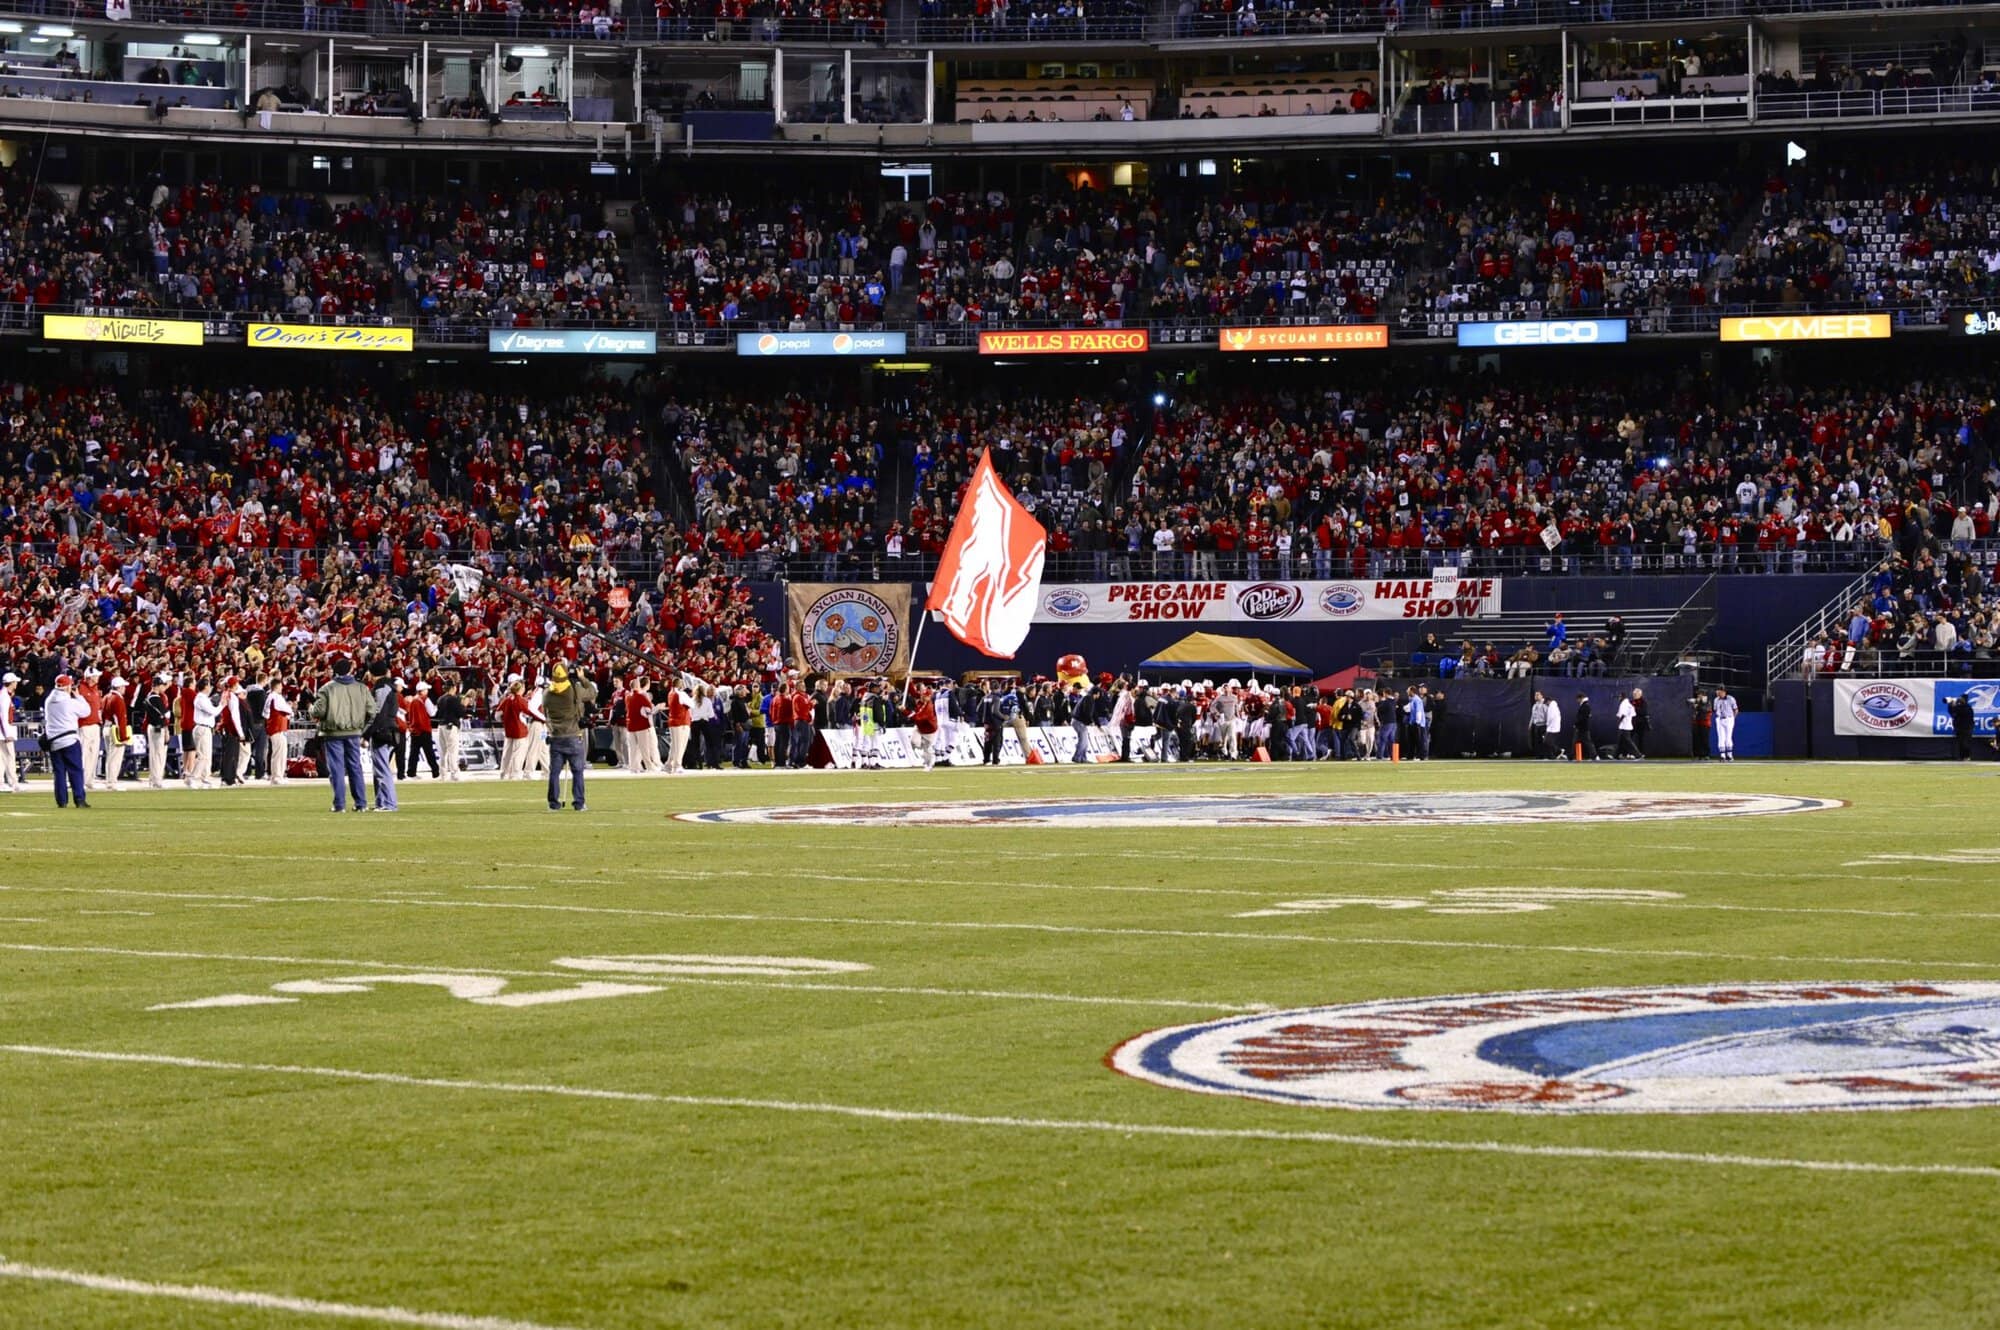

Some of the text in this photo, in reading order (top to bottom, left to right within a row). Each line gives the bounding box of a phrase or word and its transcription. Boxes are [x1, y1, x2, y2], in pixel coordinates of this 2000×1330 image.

[254, 326, 404, 347] Oggi's Pizza
[1494, 321, 1598, 345] GEICO
[1739, 317, 1872, 339] CYMER
[516, 335, 565, 351] Degree
[599, 336, 647, 352] Degree
[779, 338, 811, 351] pepsi
[854, 337, 885, 350] pepsi
[984, 333, 1144, 351] WELLS FARGO
[1258, 331, 1383, 345] SYCUAN RESORT
[241, 532, 252, 543] 12
[1108, 583, 1227, 602] PREGAME
[1262, 588, 1280, 601] Dr
[811, 591, 887, 617] SYCUAN BAND
[1128, 602, 1206, 619] SHOW
[1245, 592, 1292, 615] Pepper
[1403, 600, 1480, 618] SHOW
[880, 623, 898, 668] NATION
[804, 646, 821, 666] THE
[1861, 686, 1909, 702] PACIFIC LIFE
[1856, 709, 1911, 728] HOLIDAY BOWL
